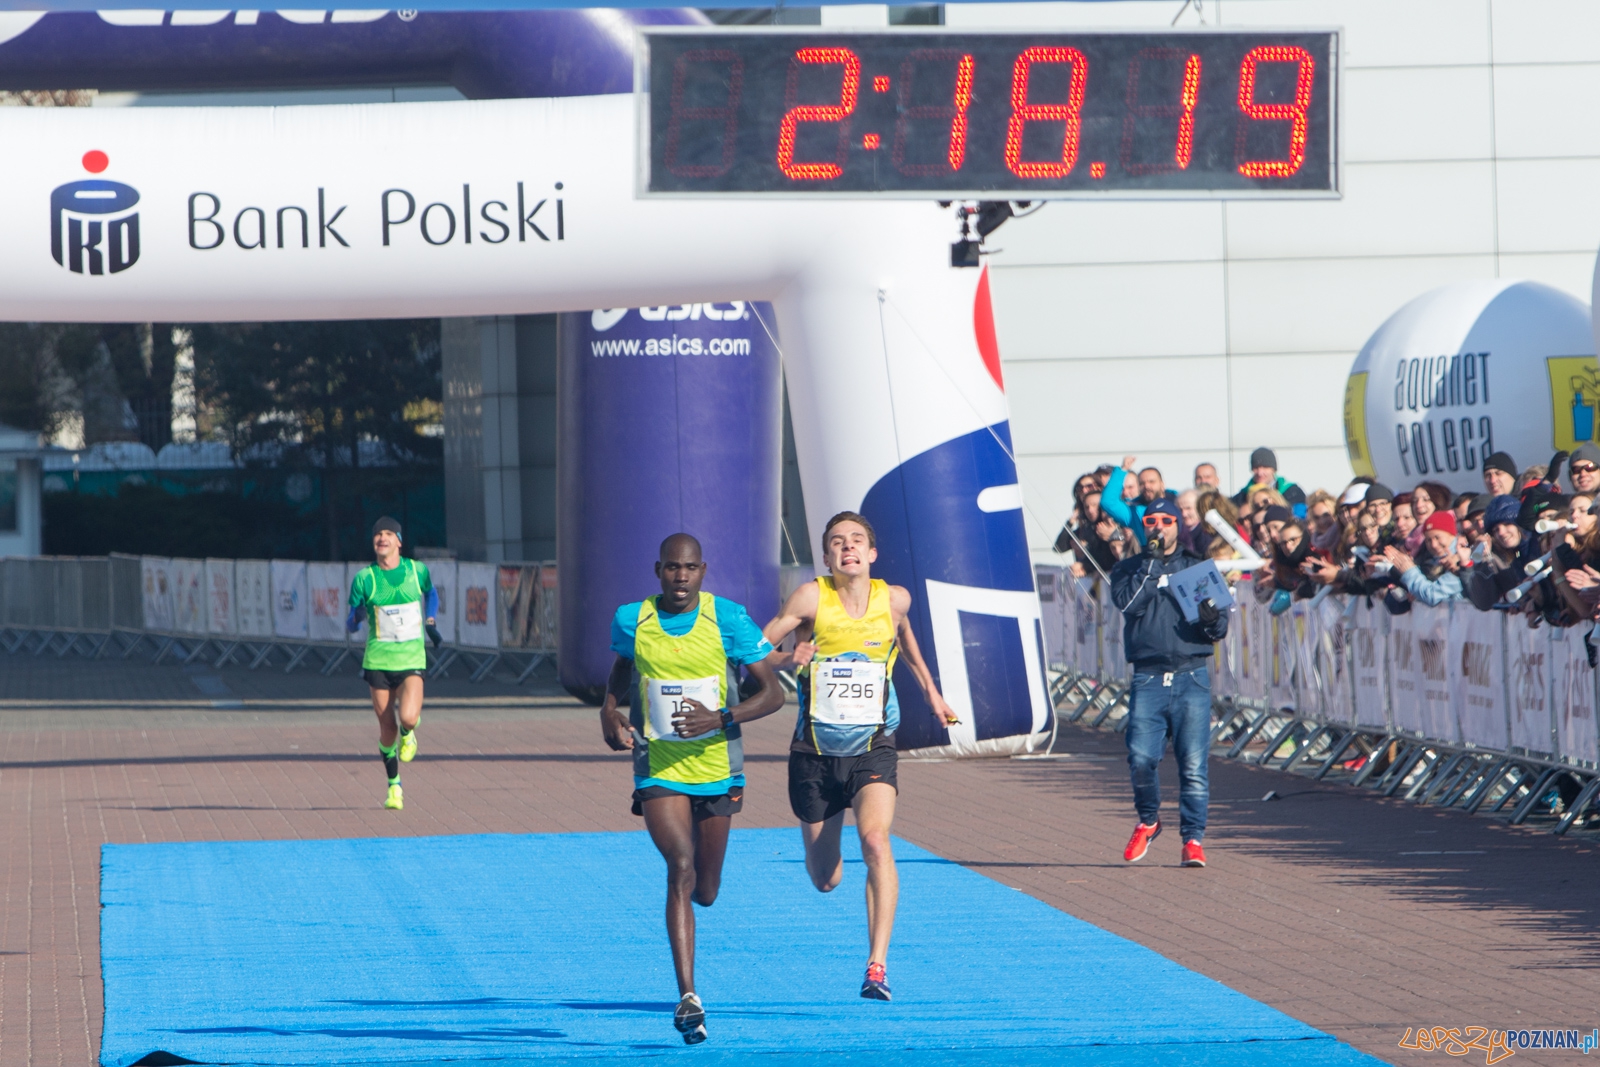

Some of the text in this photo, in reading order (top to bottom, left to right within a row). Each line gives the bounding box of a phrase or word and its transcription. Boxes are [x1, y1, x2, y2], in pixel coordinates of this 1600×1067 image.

[776, 46, 1316, 181] 2:18.19
[187, 181, 566, 250] Bank Polski
[591, 334, 750, 357] www.asics.com
[826, 683, 874, 699] 7296
